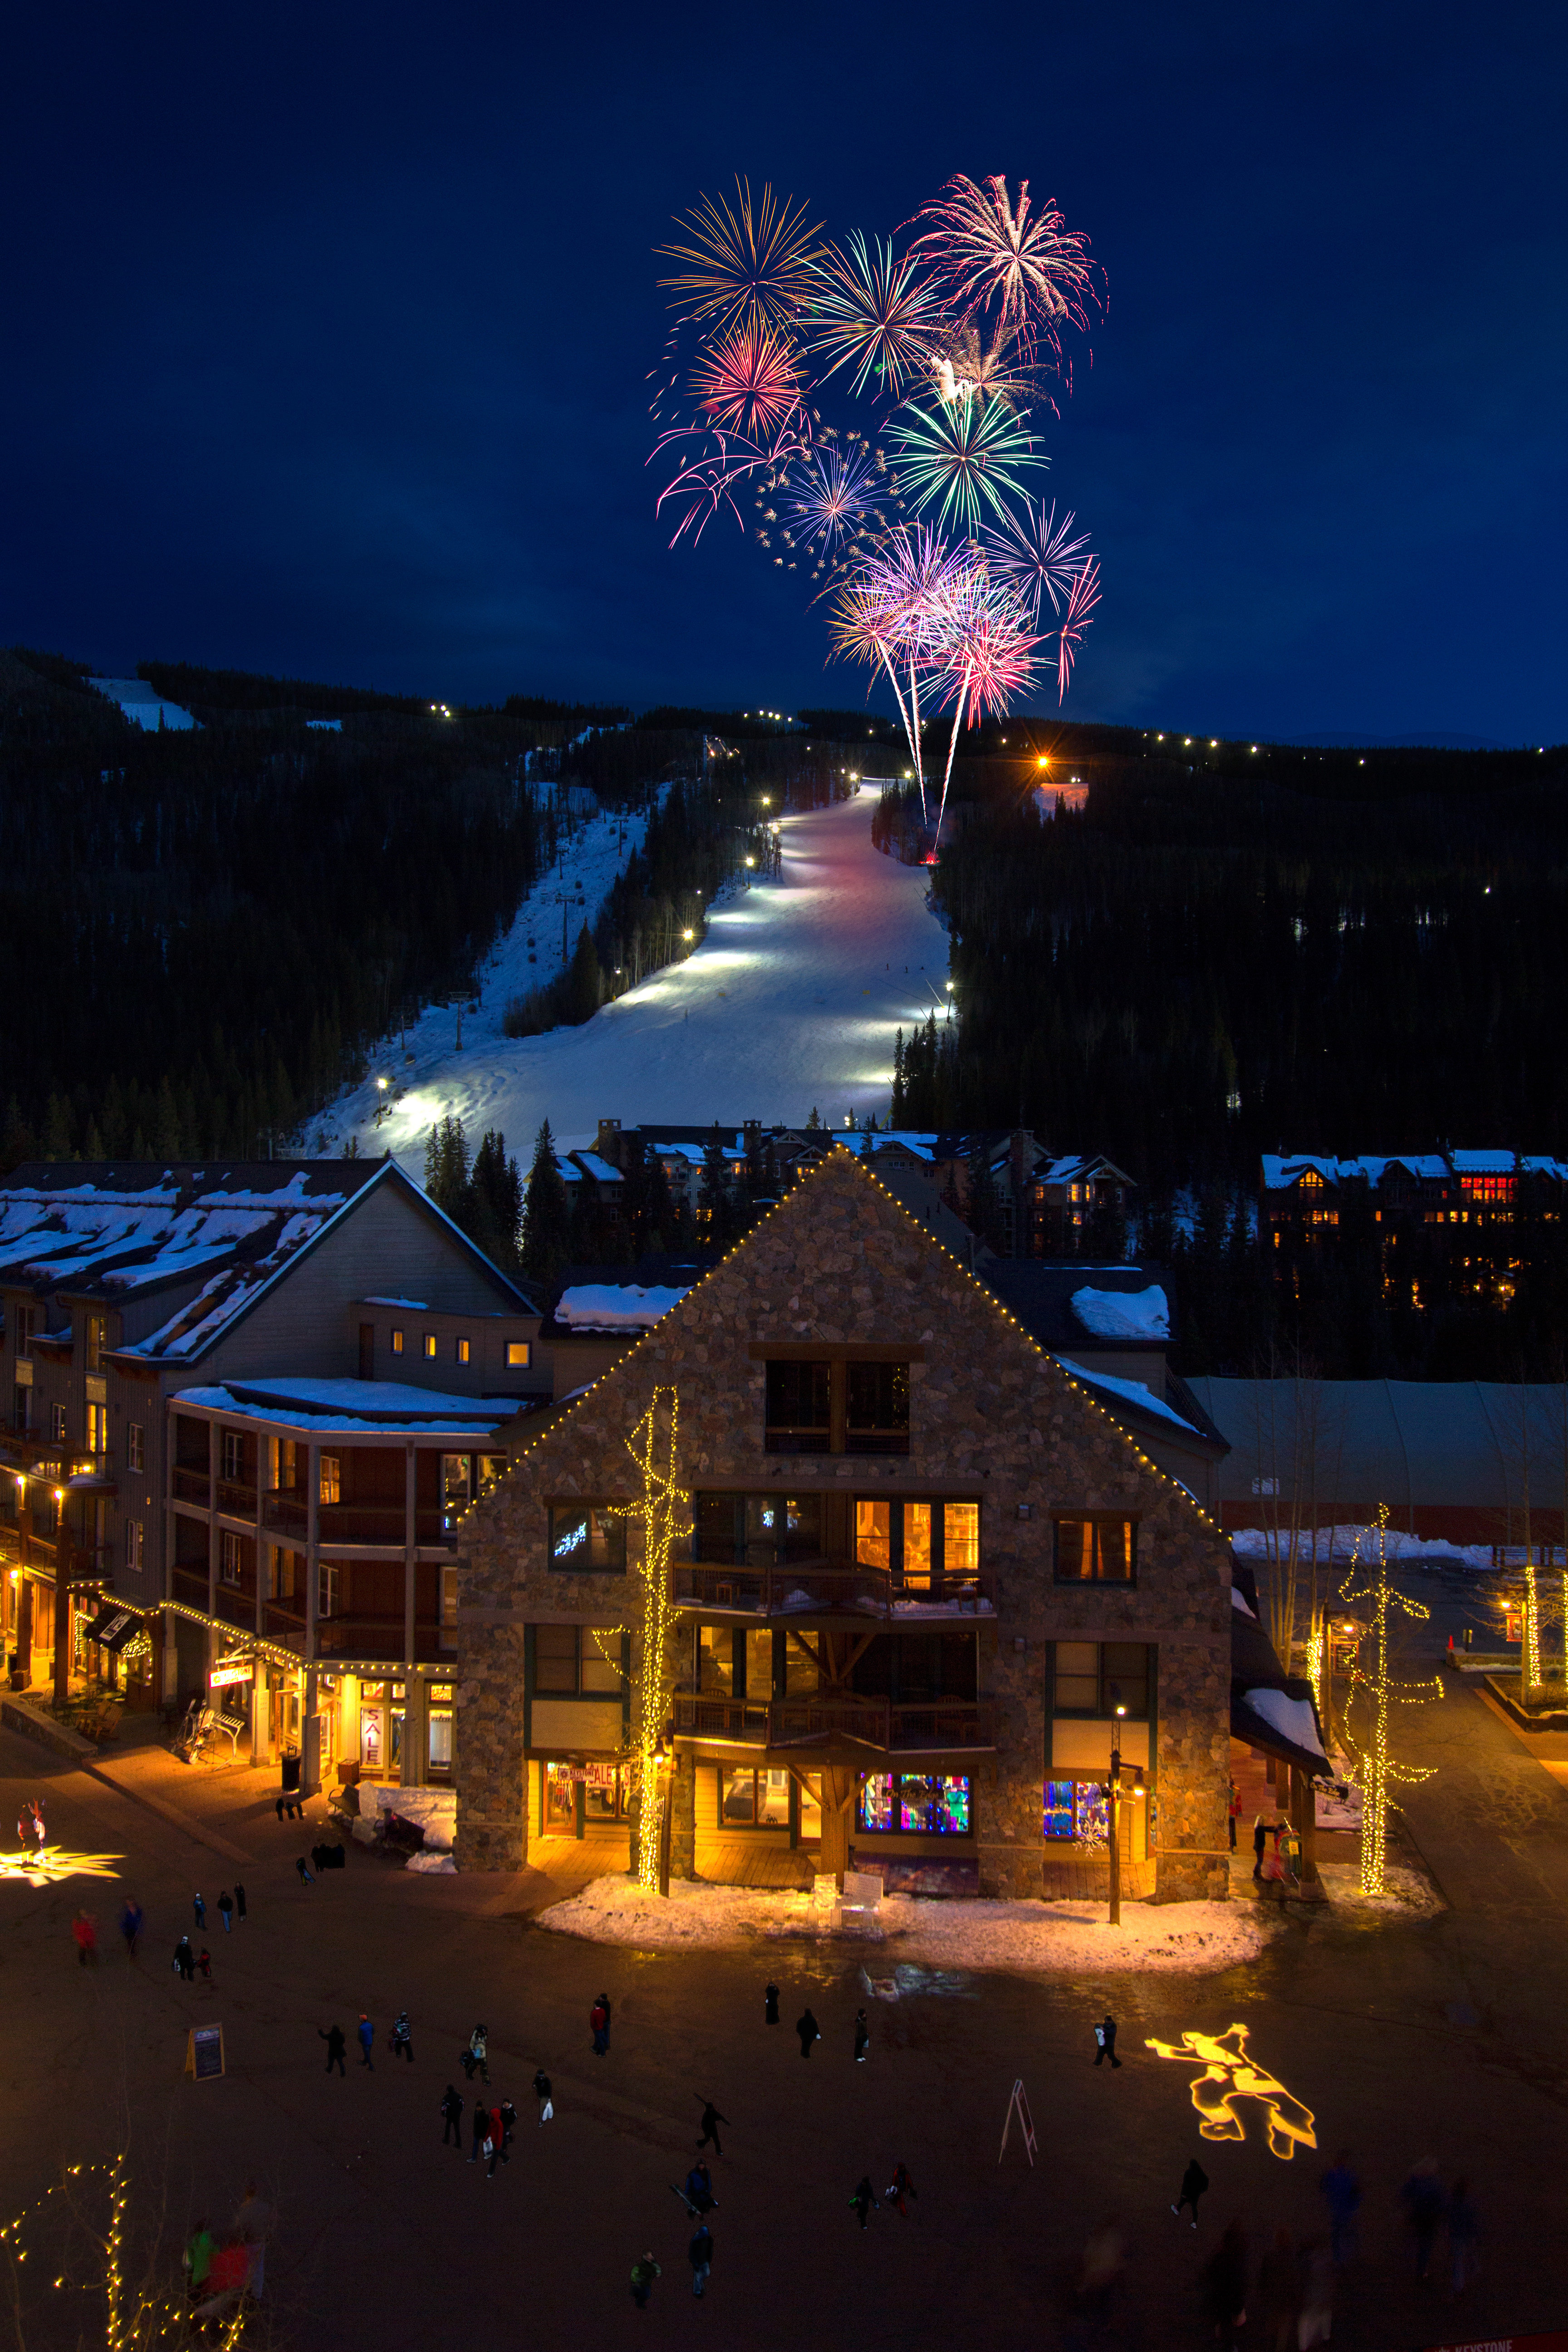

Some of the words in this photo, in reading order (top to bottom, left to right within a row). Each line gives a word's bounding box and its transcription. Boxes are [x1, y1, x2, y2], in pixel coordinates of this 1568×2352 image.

[224, 1666, 251, 1678] STONE
[365, 1709, 381, 1761] SALE
[886, 1788, 898, 1798] On
[900, 1788, 916, 1798] The
